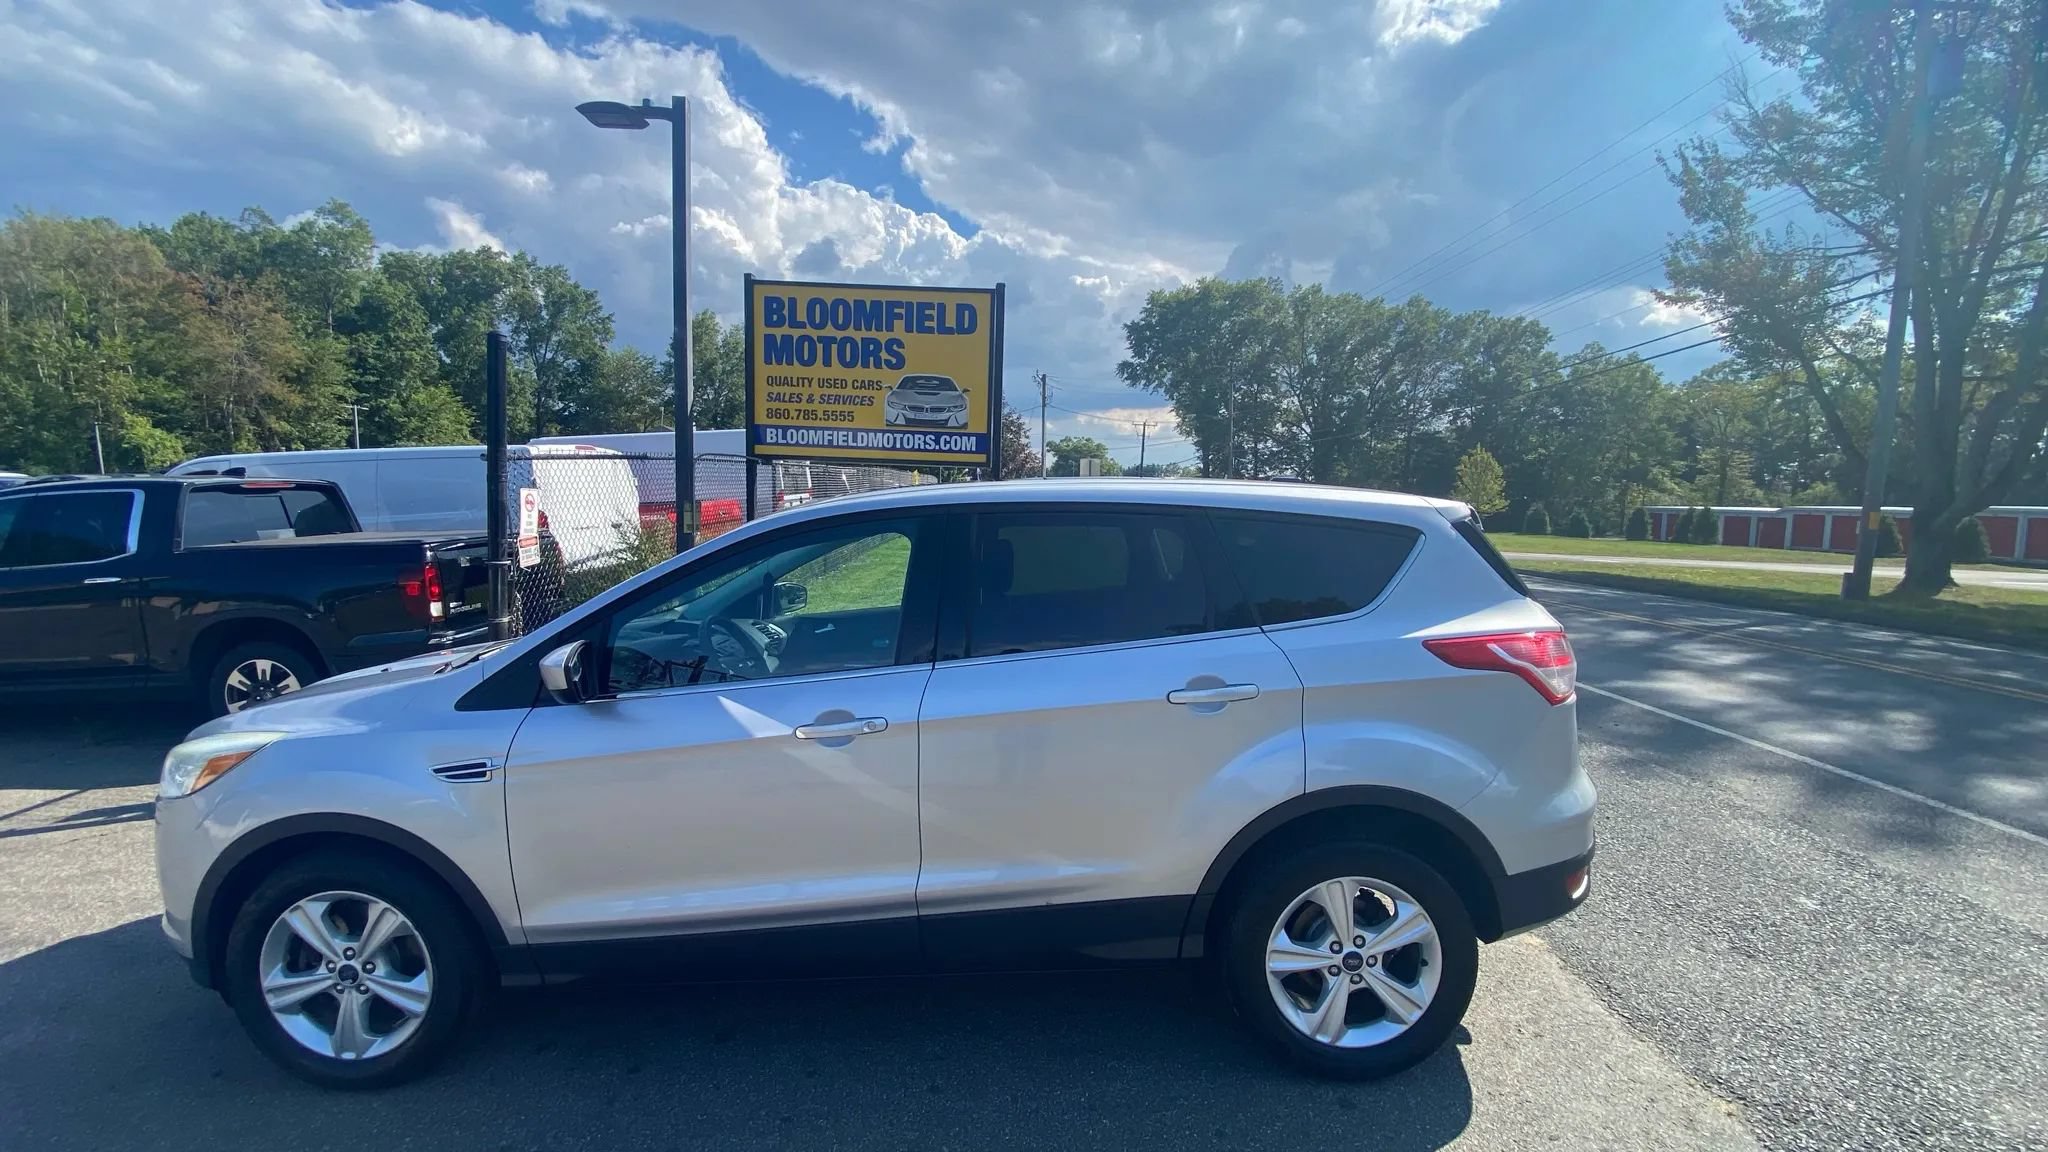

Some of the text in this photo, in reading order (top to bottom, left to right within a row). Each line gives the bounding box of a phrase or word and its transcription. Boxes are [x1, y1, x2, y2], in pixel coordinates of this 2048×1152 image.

[764, 296, 978, 335] BLOOMFIELD
[764, 334, 906, 370] MOTORS
[766, 376, 882, 391] QUALITY USED CARS
[766, 392, 875, 406] SALES & SERVICES
[766, 408, 855, 422] 860.785.5555
[766, 428, 977, 451] BLOOMFIELDMOTORS.COM
